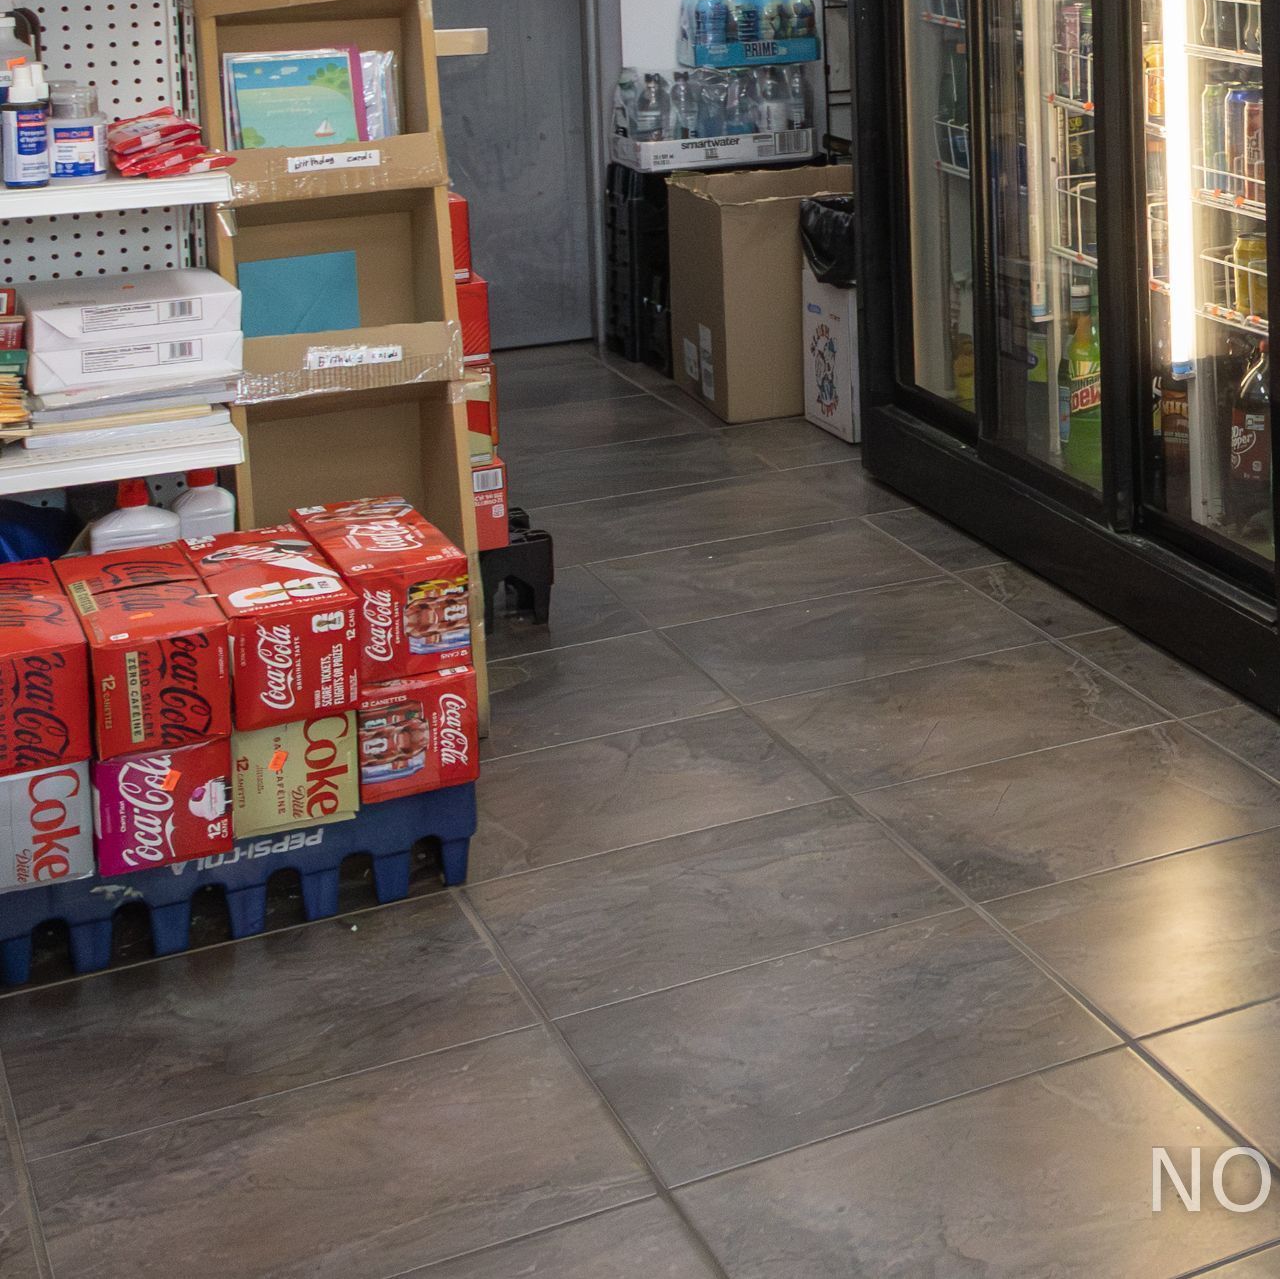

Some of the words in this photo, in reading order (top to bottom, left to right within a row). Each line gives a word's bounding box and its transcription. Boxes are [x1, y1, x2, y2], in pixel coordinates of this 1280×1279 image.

[744, 41, 778, 58] PRIME
[680, 137, 740, 150] smartwater
[348, 609, 356, 628] CANS
[346, 629, 356, 641] 12
[333, 643, 343, 669] PRIZES
[320, 653, 332, 683] TICKETS,
[101, 674, 116, 693] 12
[334, 677, 344, 705] FLIGHTS
[321, 683, 333, 707] SCORE
[236, 757, 249, 772] 12
[303, 712, 349, 819] Coke
[28, 768, 81, 882] Coke
[207, 822, 222, 840] 12
